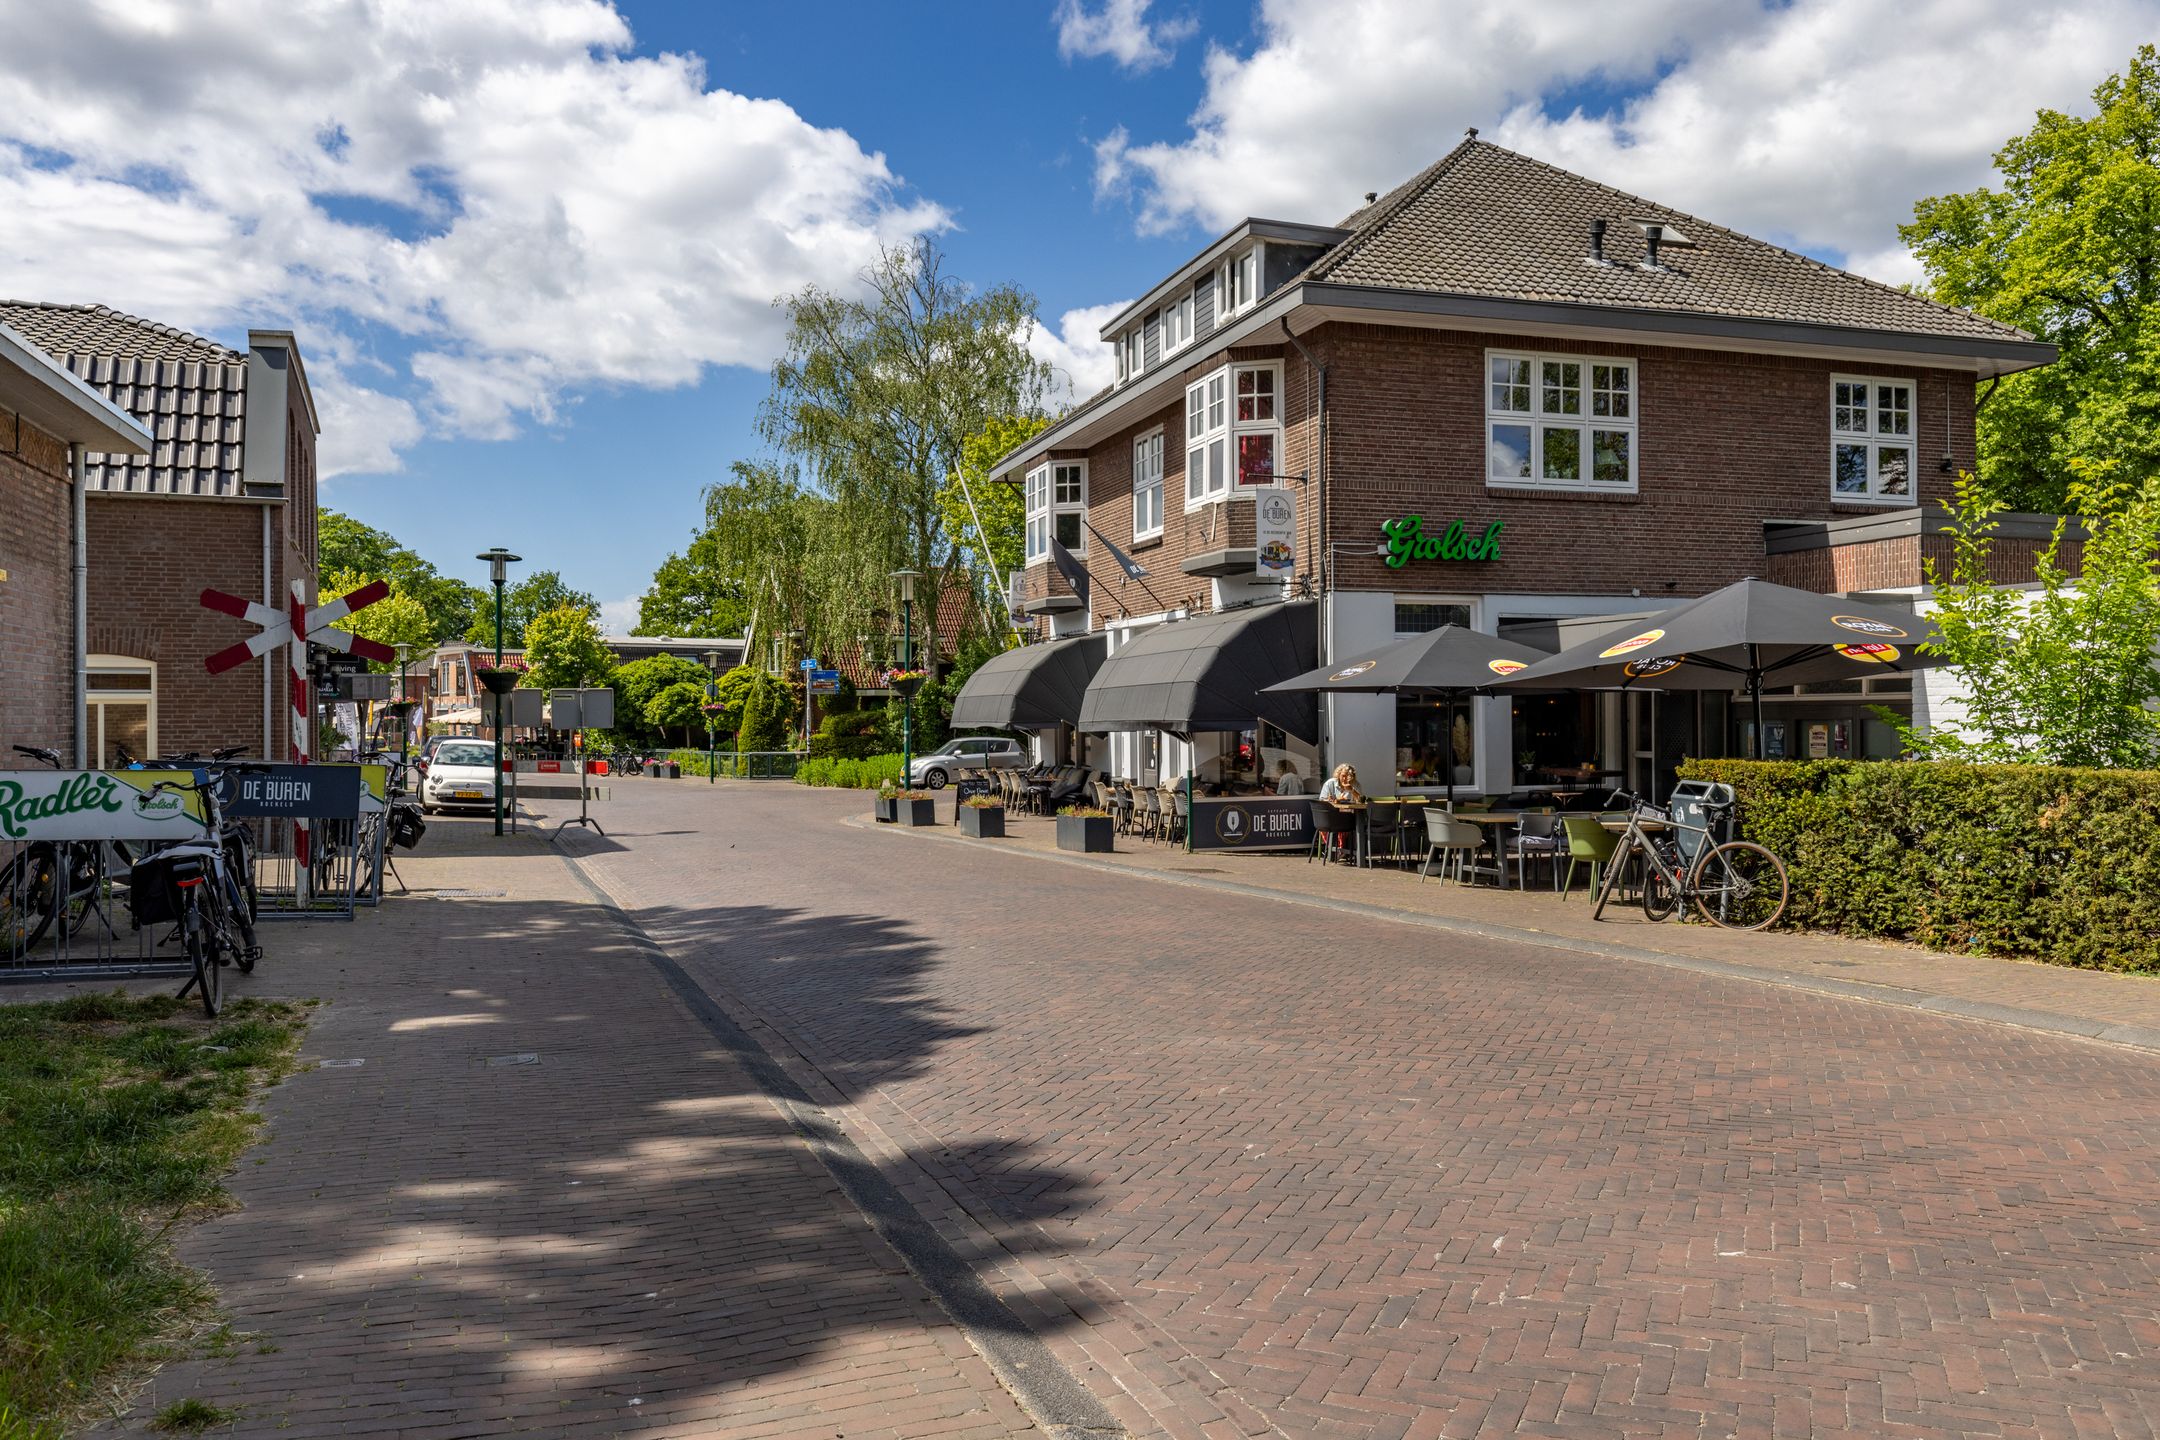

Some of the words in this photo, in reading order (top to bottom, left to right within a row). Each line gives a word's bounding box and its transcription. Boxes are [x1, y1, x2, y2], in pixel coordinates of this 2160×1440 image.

[1263, 509, 1270, 520] DE
[1272, 509, 1292, 520] BUREN
[1381, 515, 1505, 569] Grolsch
[243, 781, 261, 800] DE
[266, 781, 311, 801] BUREN
[0, 772, 123, 837] Radler
[1253, 814, 1267, 832] DE
[1269, 813, 1302, 831] BUREN
